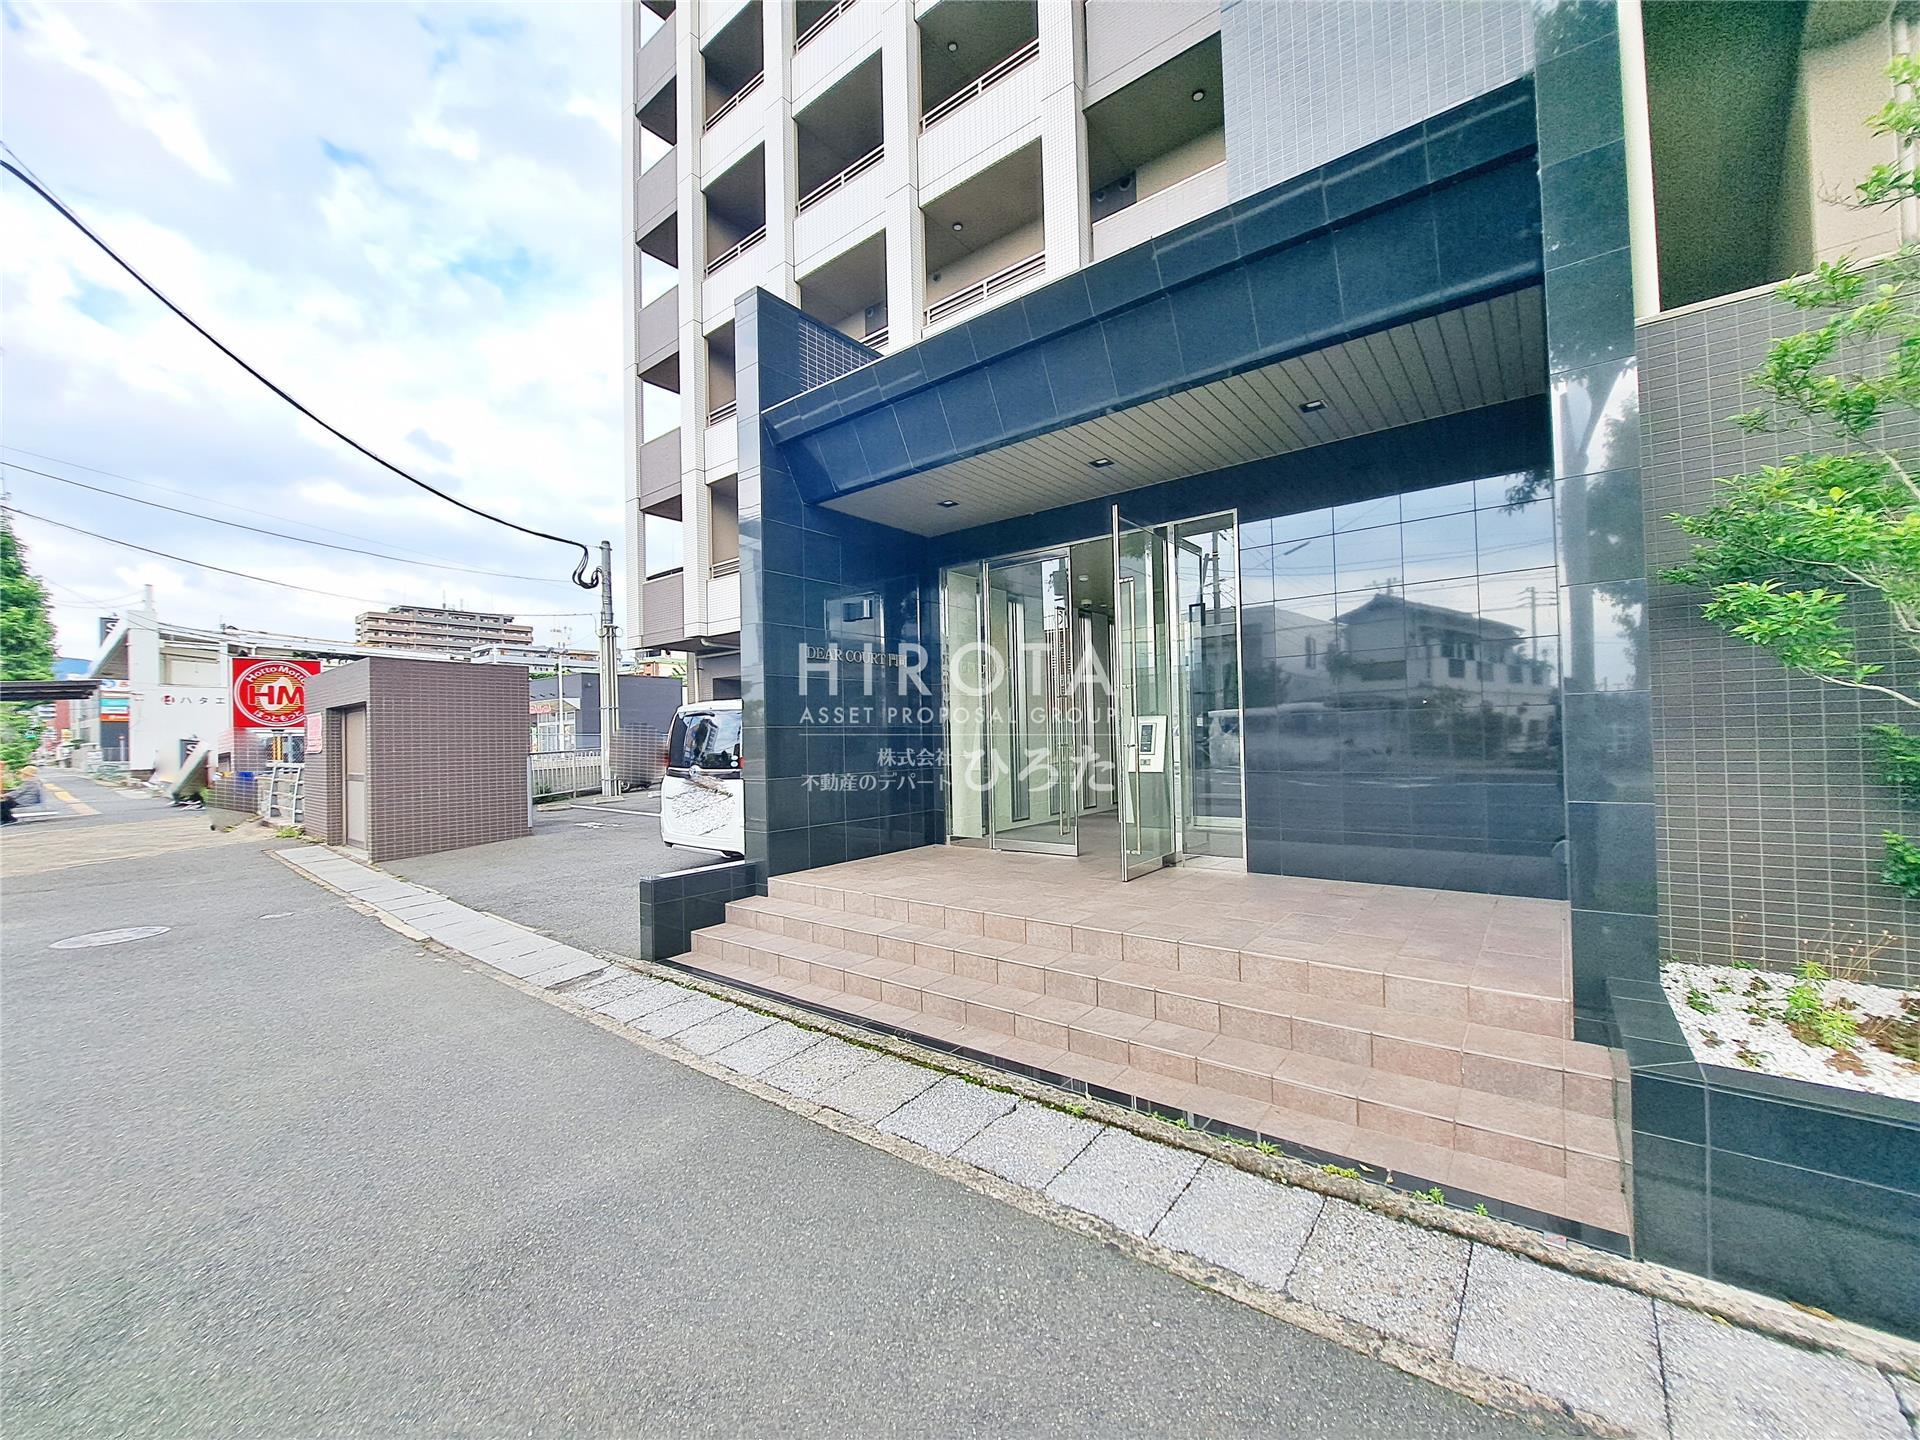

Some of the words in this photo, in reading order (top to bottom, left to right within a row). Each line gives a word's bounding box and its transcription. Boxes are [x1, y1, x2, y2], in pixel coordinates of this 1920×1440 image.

[807, 646, 843, 661] DEAR
[845, 650, 886, 665] COURT
[245, 666, 278, 682] Hotto
[248, 684, 305, 706] HM
[253, 709, 304, 722] ほっともっと
